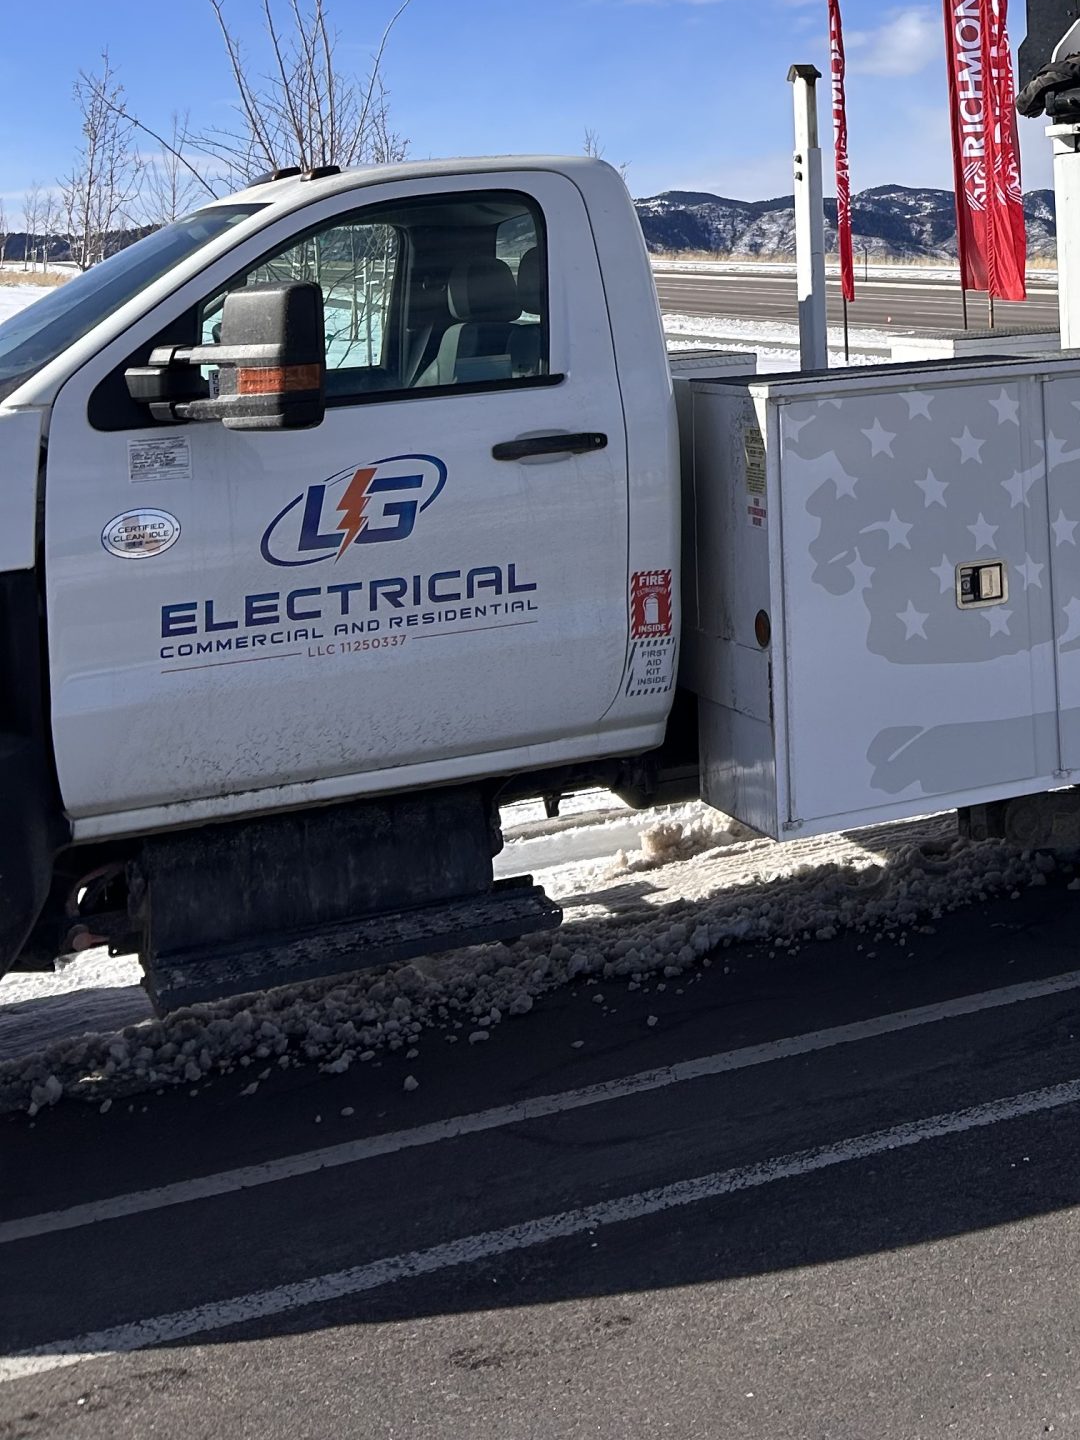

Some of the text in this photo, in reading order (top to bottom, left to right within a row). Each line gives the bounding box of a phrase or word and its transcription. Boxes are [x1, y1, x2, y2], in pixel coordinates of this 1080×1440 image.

[117, 522, 166, 534] CERTIFIED
[113, 532, 146, 543] CLEAN
[149, 530, 170, 539] IDLE
[639, 574, 665, 587] FIRE
[161, 563, 537, 639] ELECTRICAL
[160, 599, 539, 659] COMMERCIAL AND RESIDENTIAL
[638, 623, 667, 634] INSIDE
[308, 634, 407, 658] LLC 11250337
[641, 648, 668, 659] FIRST
[646, 658, 662, 667] AID
[646, 667, 661, 677] KIT
[637, 675, 668, 686] INSIDE
